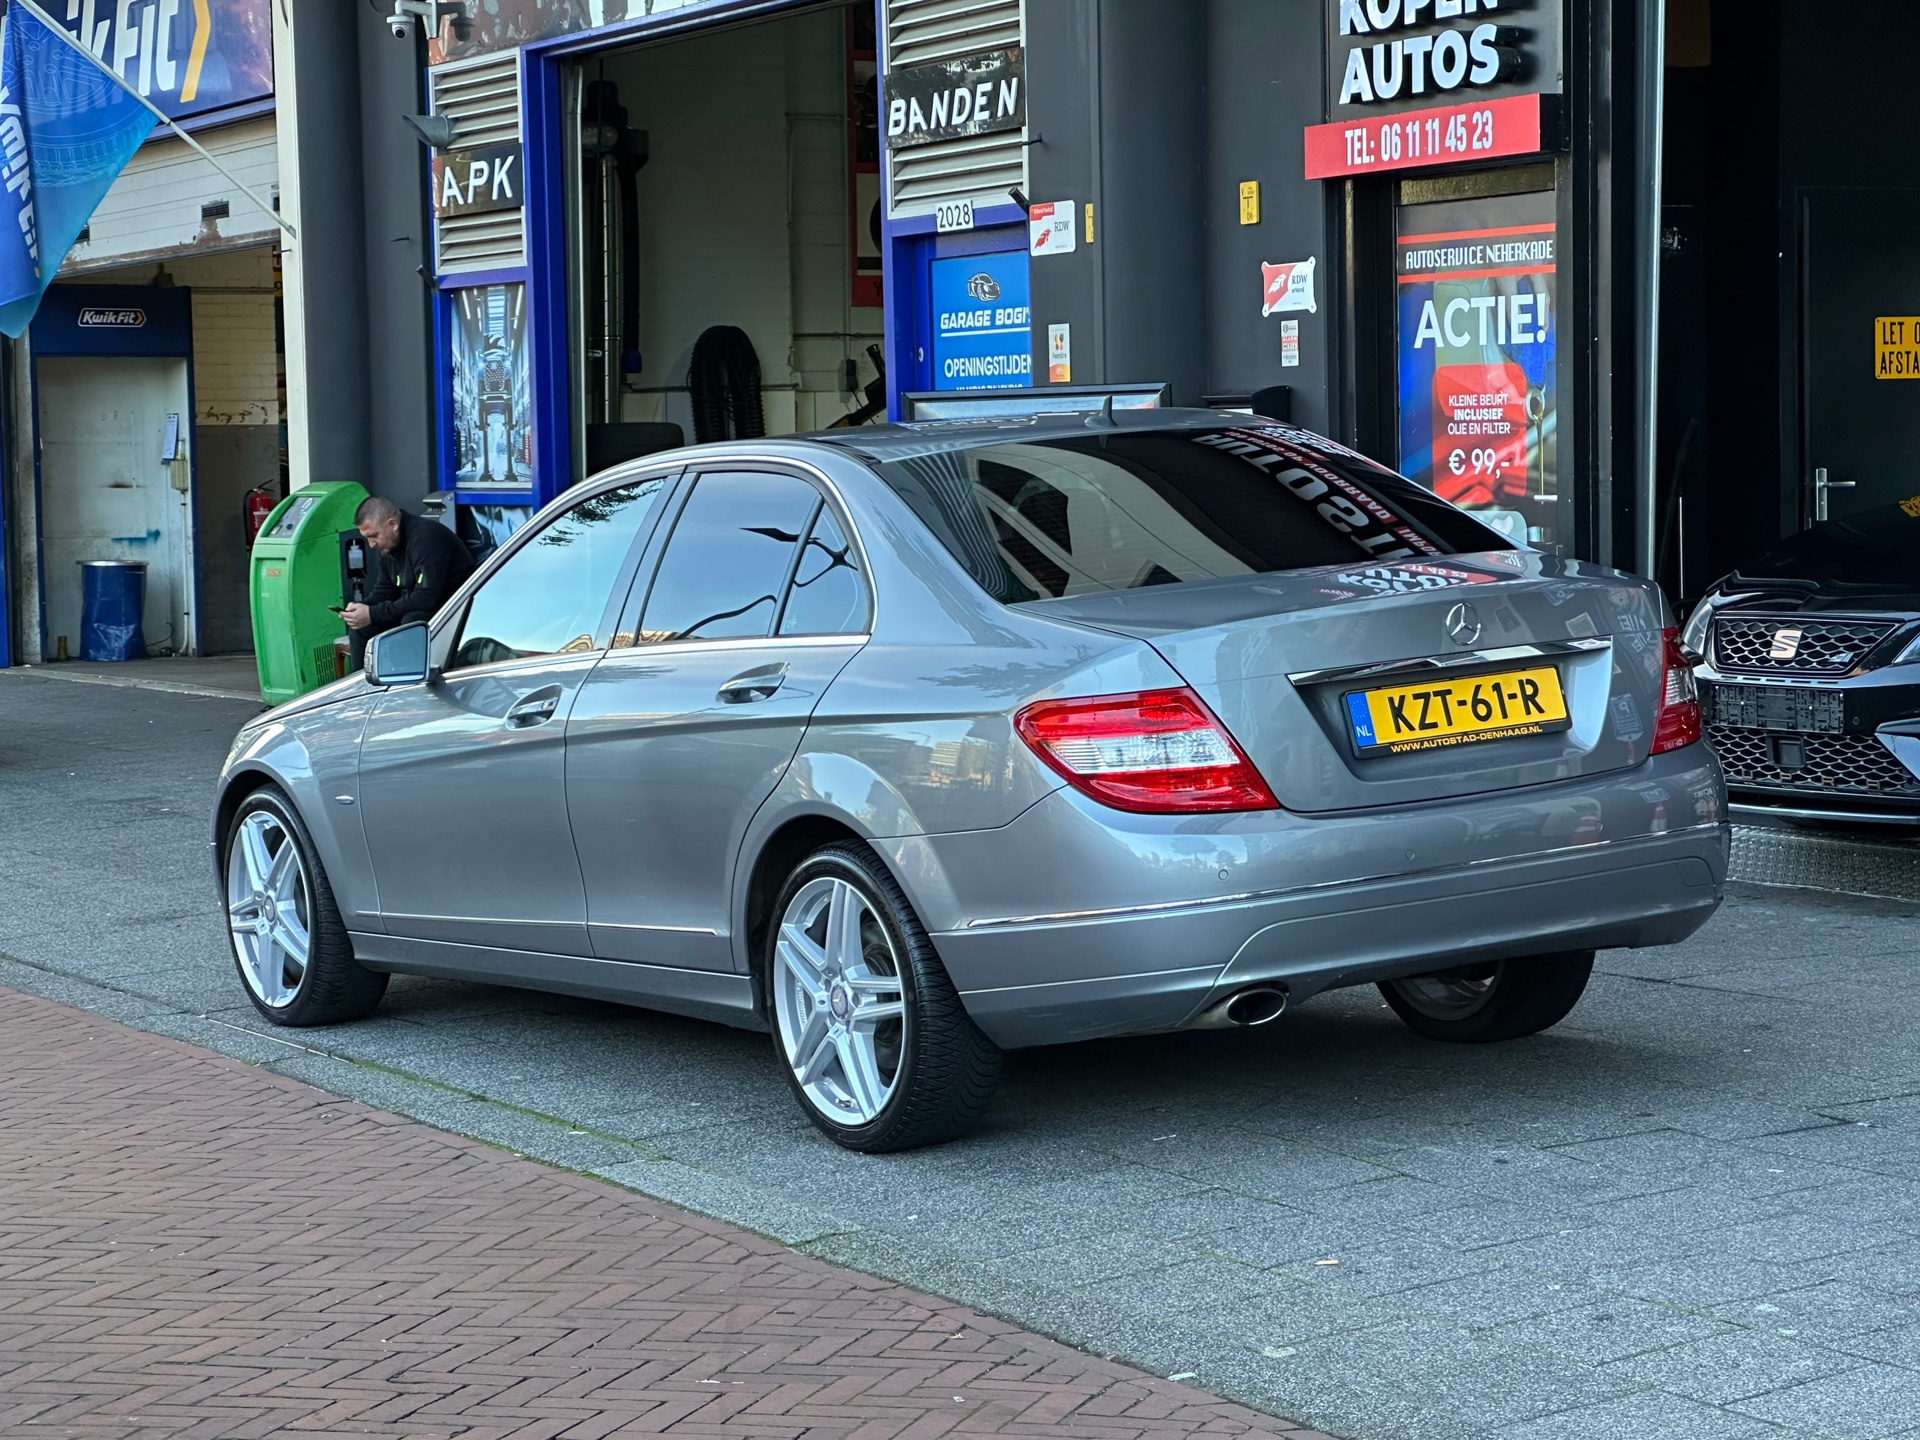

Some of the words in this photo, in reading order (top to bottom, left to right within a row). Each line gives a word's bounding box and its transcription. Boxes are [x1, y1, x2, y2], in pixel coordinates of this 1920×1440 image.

[1339, 23, 1500, 104] AUTOS
[887, 77, 1018, 136] BANDEN
[1345, 127, 1375, 166] TEL:
[1380, 122, 1401, 162] 06
[1405, 120, 1420, 158] 11
[1425, 117, 1440, 155] 11
[1445, 113, 1467, 152] 45
[1472, 109, 1493, 150] 23
[441, 155, 516, 207] APK
[937, 203, 971, 229] 2028
[1054, 220, 1069, 232] RDW
[1405, 246, 1484, 269] AUTOSERVICE
[1486, 240, 1554, 263] NEHERKADE
[1291, 274, 1307, 284] RDW
[940, 309, 991, 330] GARAGE
[1413, 293, 1546, 349] ACTIE!
[1882, 321, 1905, 345] LET
[1448, 394, 1478, 407] KLEINE
[1479, 393, 1508, 406] BEURT
[1447, 422, 1467, 435] OLIE
[1469, 422, 1480, 435] EN
[1482, 421, 1511, 435] FILTER
[1454, 408, 1504, 421] INCLUSIEF
[1448, 448, 1466, 476] €
[1387, 678, 1546, 734] KZT-61-R
[1356, 725, 1373, 738] NL
[1390, 725, 1543, 753] WWW.AUTOSTAD-DENHAAG.NL
